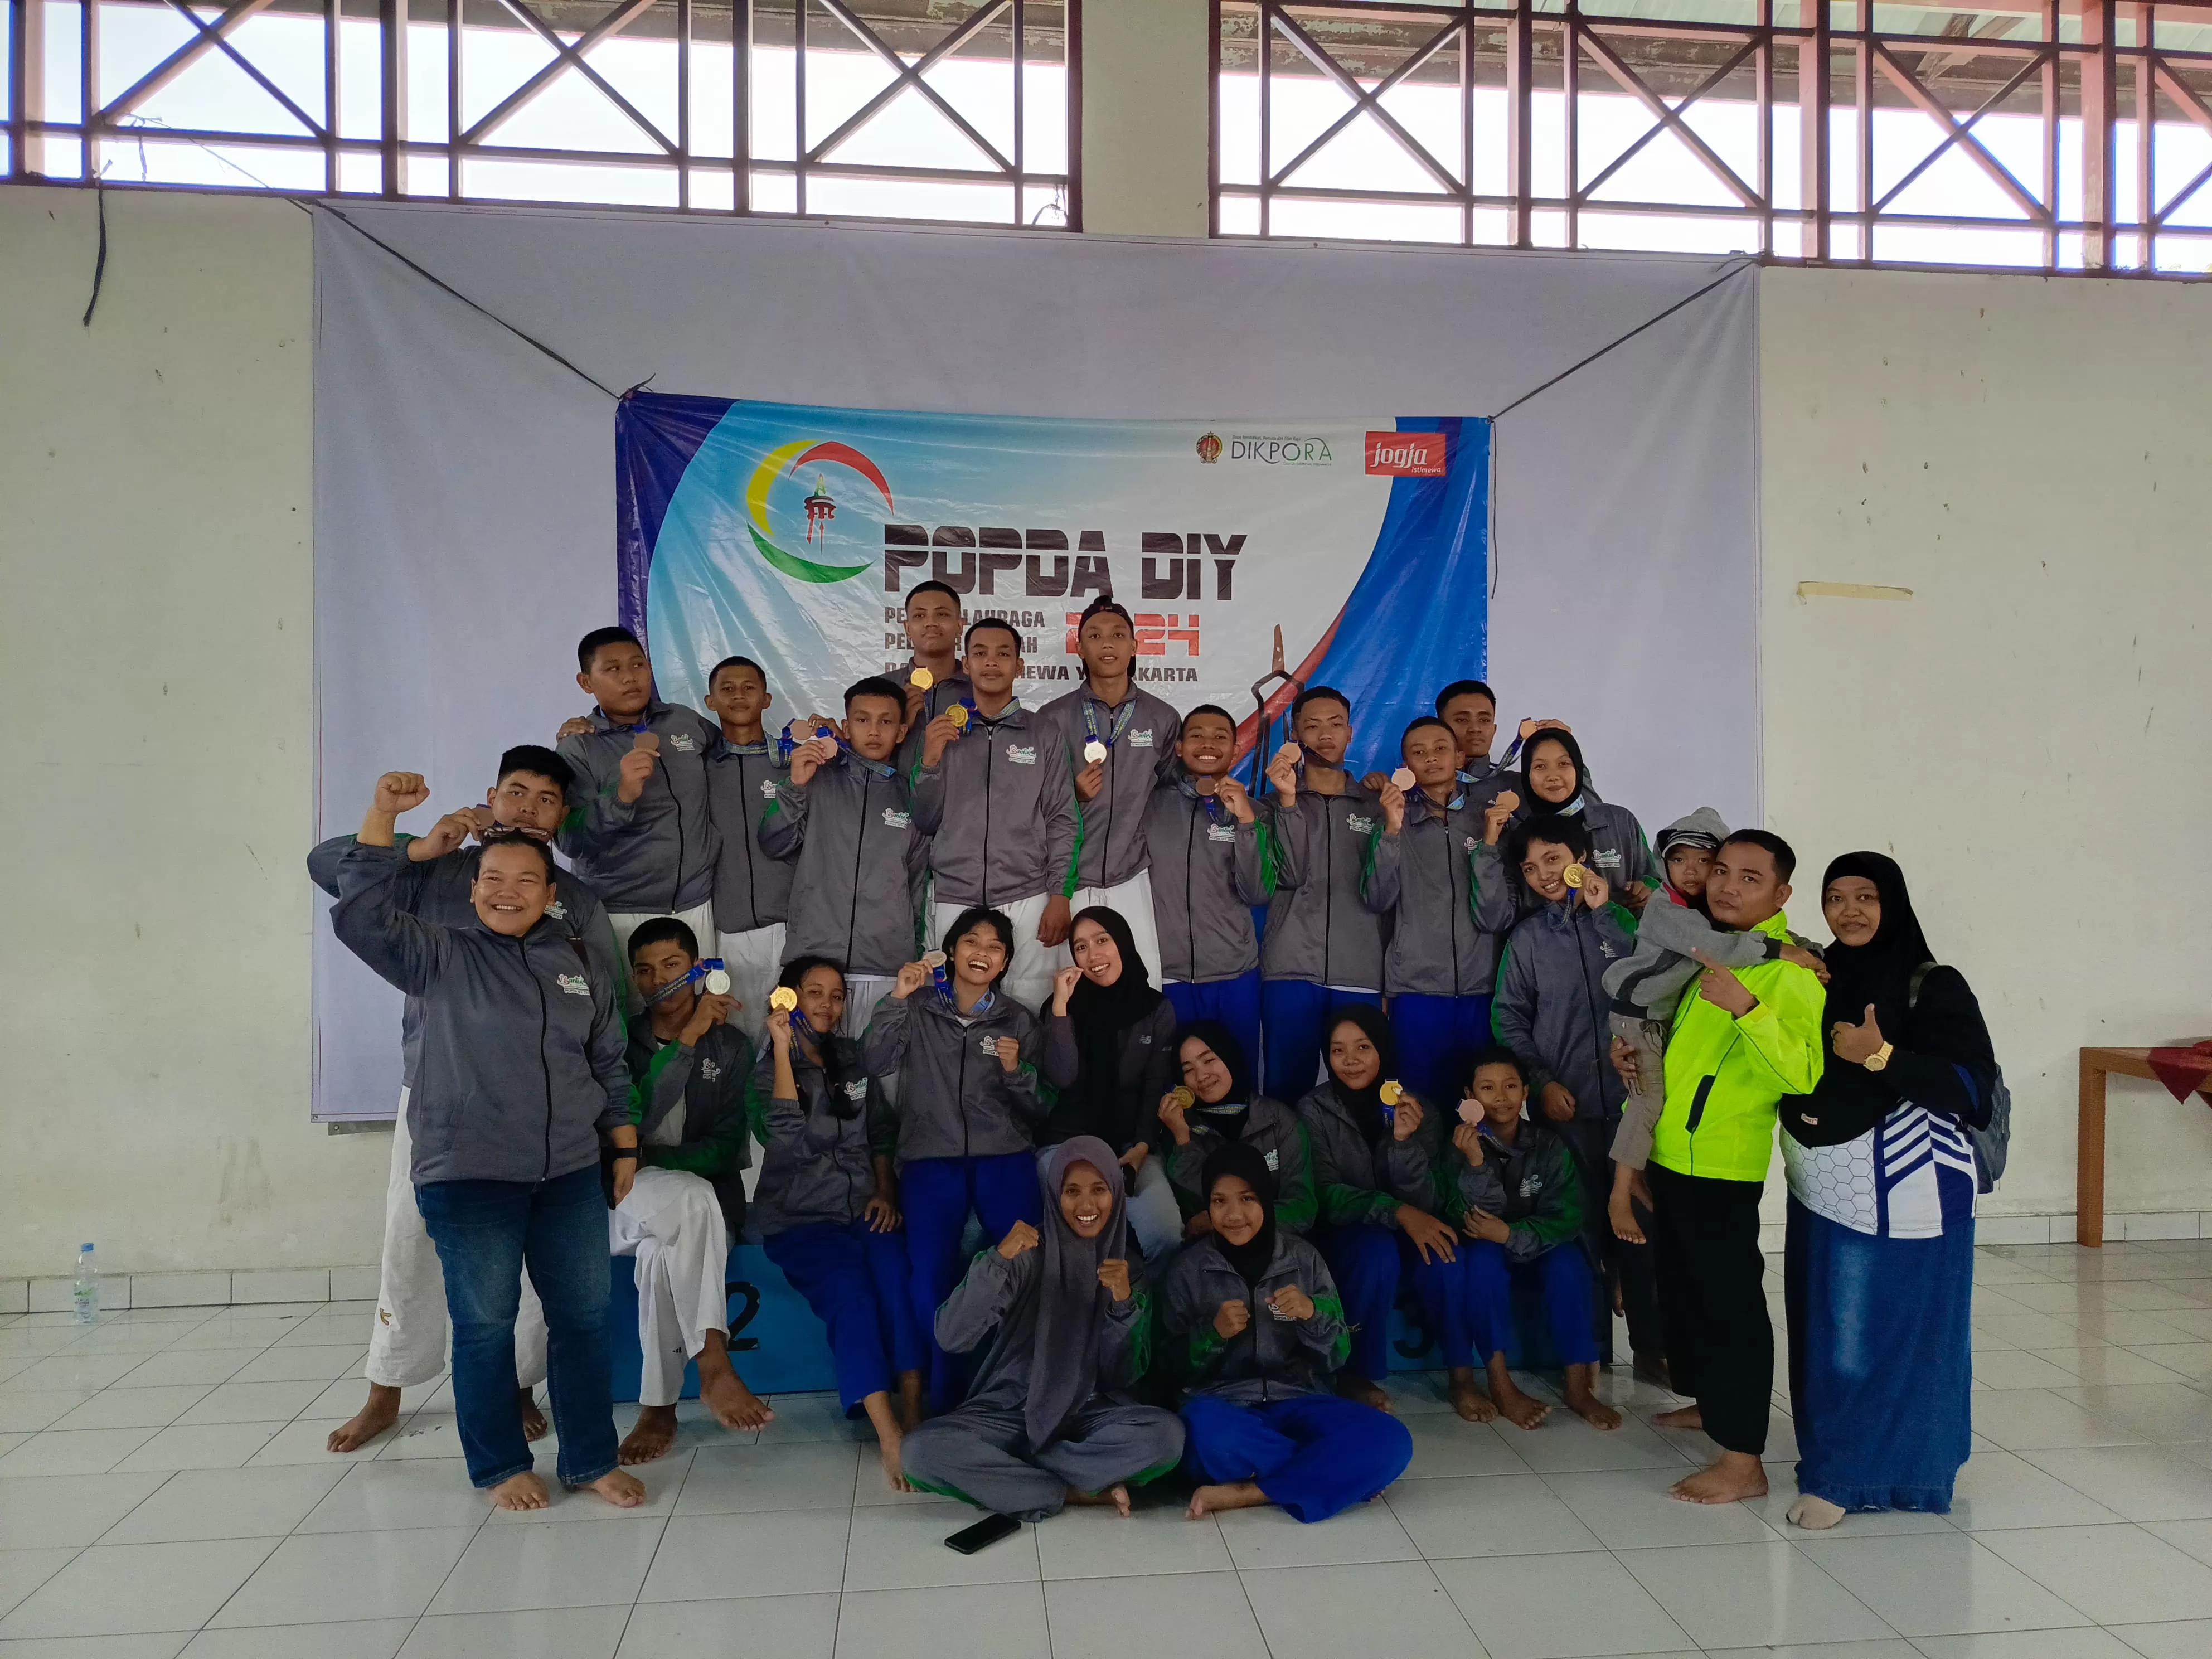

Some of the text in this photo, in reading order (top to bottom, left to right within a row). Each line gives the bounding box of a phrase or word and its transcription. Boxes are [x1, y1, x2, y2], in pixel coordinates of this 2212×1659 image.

[1231, 438, 1332, 464] DIKPORA
[1370, 442, 1428, 468] jogja
[885, 524, 1248, 600] POPDA DIY
[961, 609, 1045, 628] LAHRAGA
[1066, 612, 1199, 656] 224
[725, 1281, 760, 1352] 2
